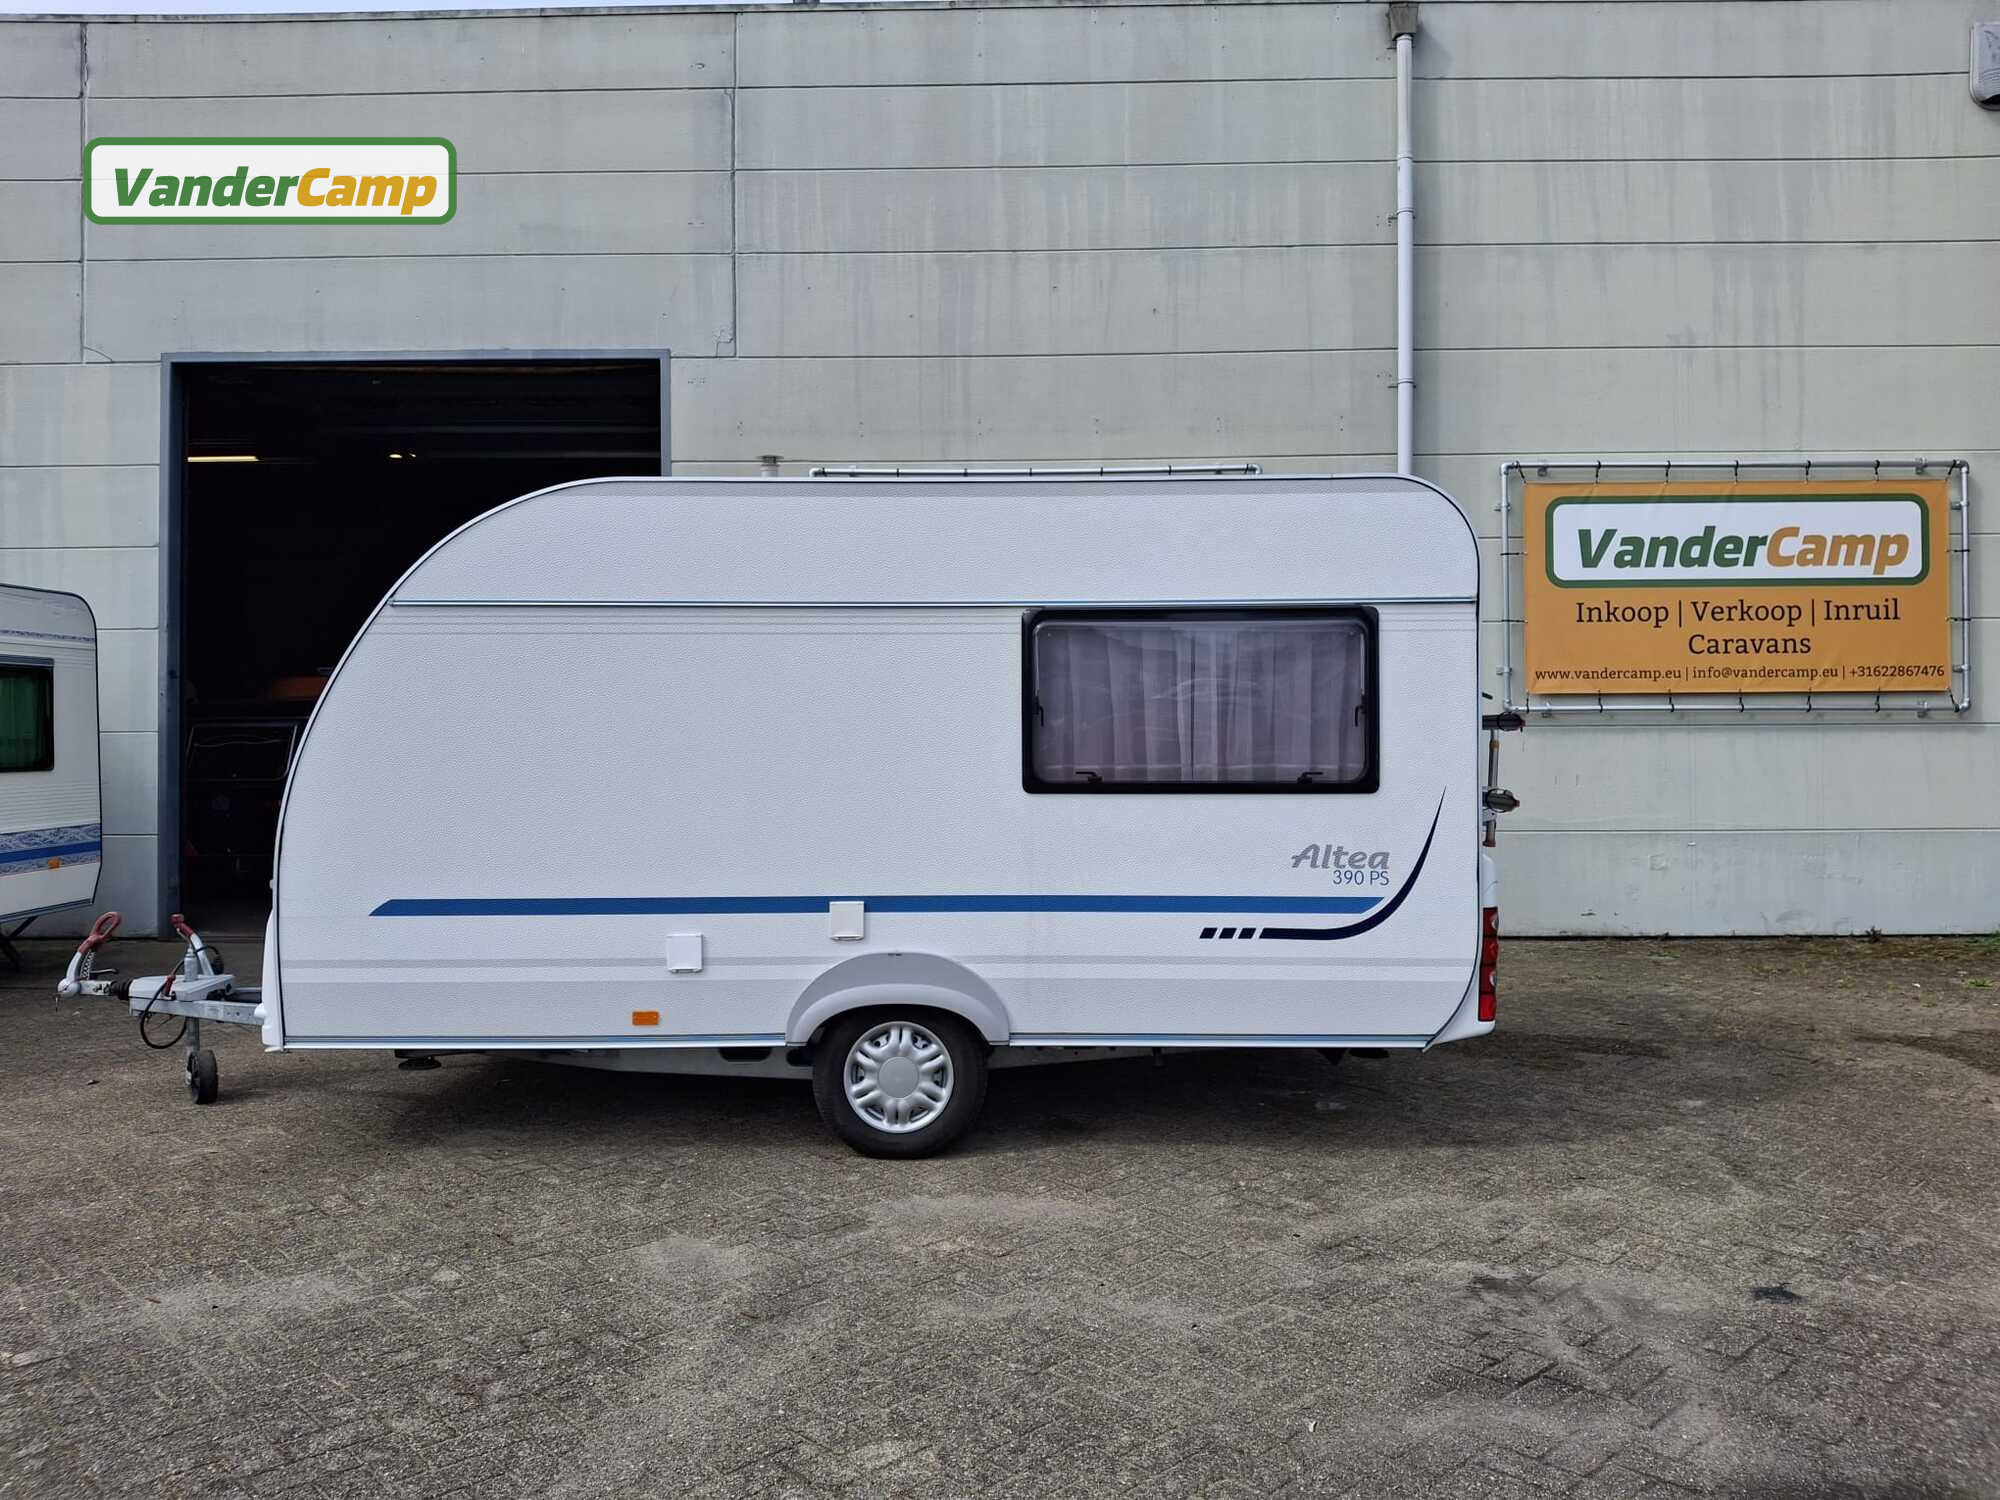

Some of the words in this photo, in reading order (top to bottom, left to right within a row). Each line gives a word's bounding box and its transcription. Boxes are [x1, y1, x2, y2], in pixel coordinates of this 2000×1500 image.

[1577, 525, 1910, 575] VanderCamp
[1576, 601, 1669, 628] Inkoop
[1690, 599, 1802, 626] Verkoop
[1823, 598, 1901, 621] Inruil
[1688, 634, 1812, 655] Caravans
[1535, 668, 1682, 682] www.vandercamp.eu
[1692, 666, 1839, 681] info@vandercamp.eu
[1849, 664, 1945, 678] +31622867476
[1291, 843, 1390, 869] Altea
[1332, 869, 1365, 886] 390
[1369, 870, 1390, 886] PS
